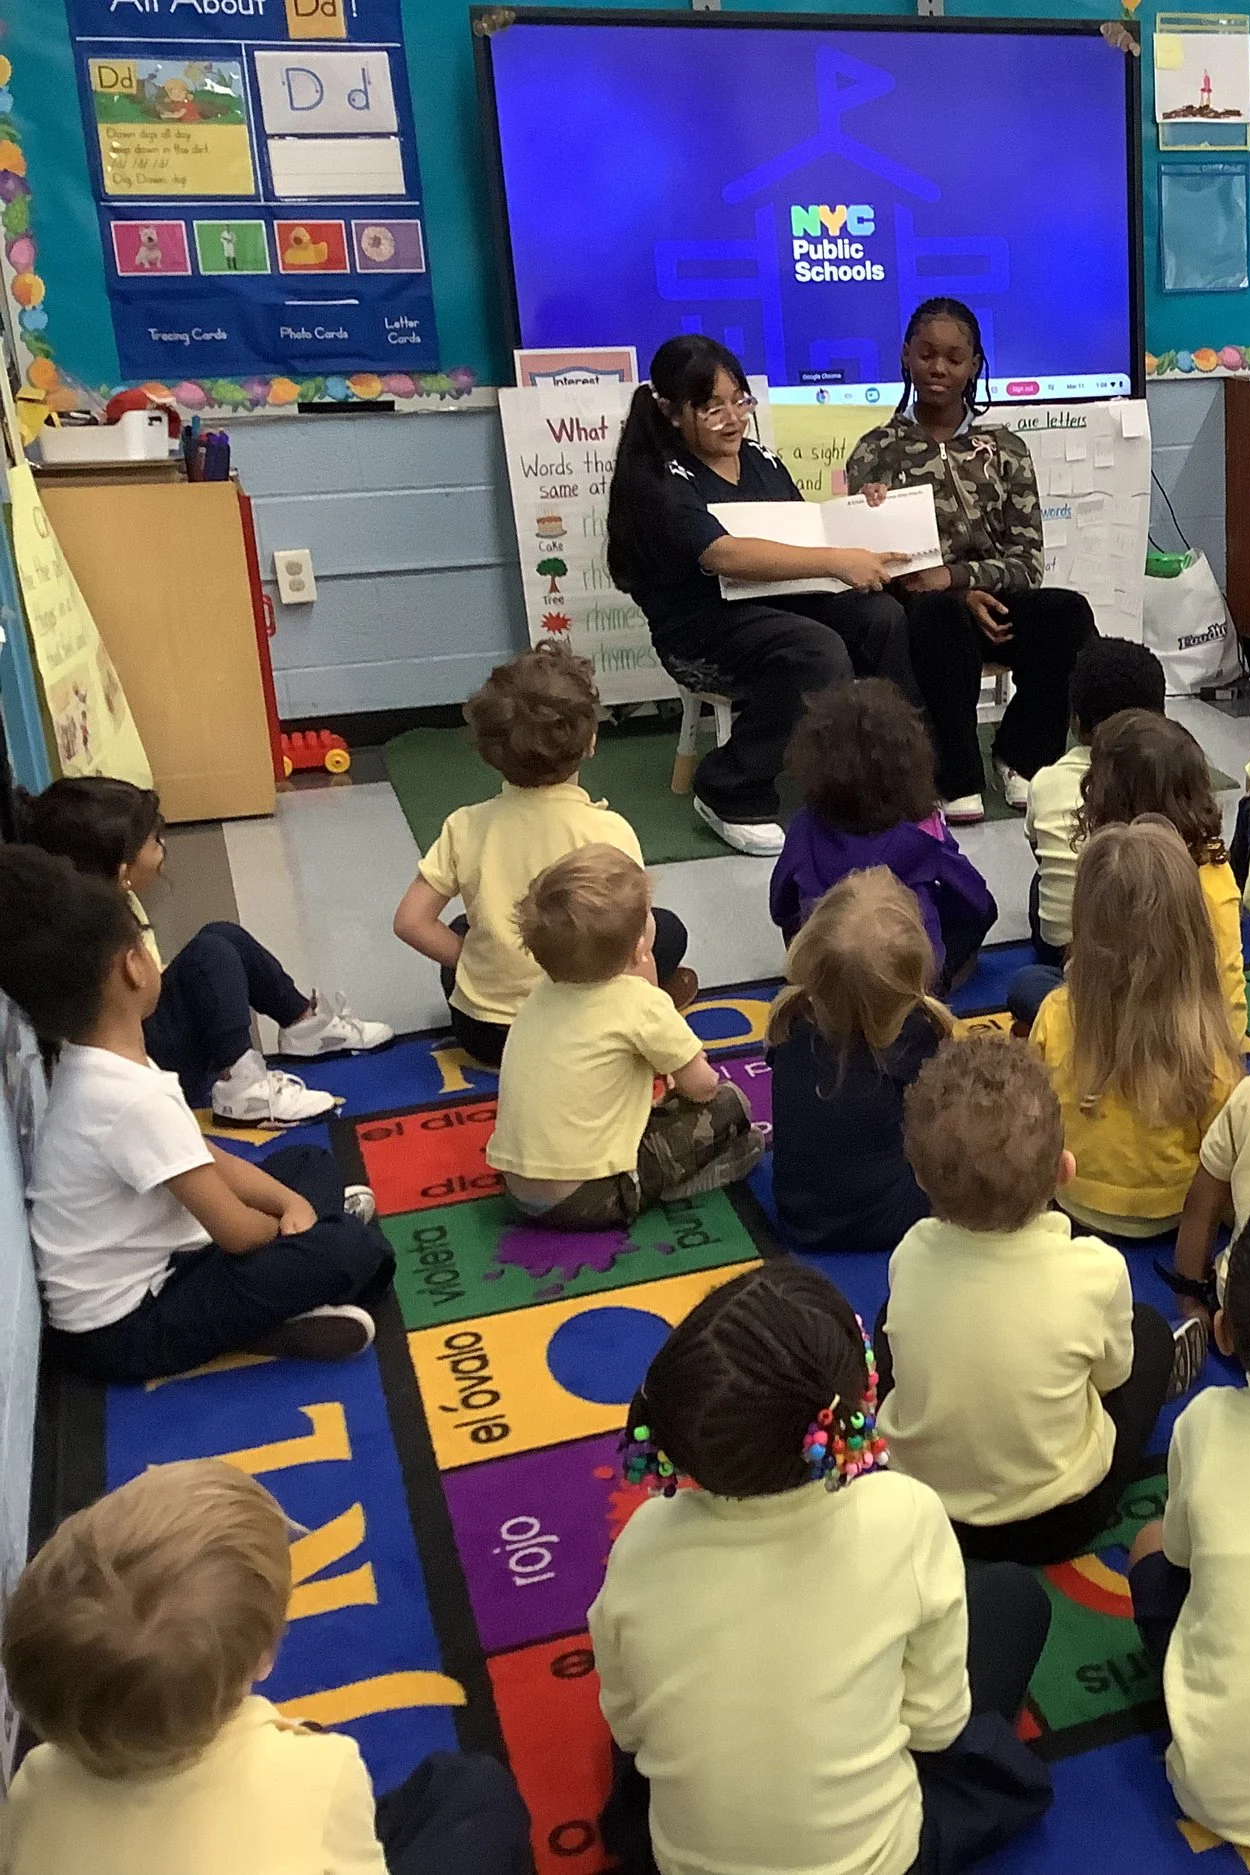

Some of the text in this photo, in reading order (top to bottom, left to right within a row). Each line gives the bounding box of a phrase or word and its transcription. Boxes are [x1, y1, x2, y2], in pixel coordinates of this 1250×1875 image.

[98, 65, 134, 89] Dd
[791, 204, 876, 237] NYC
[793, 238, 864, 260] Public
[795, 260, 885, 283] Schools
[279, 326, 349, 340] Photo Cards
[546, 414, 609, 444] What
[1046, 410, 1087, 429] letters
[520, 451, 574, 479] Words
[811, 437, 847, 467] sight
[539, 475, 607, 500] same at
[538, 540, 564, 552] Cake
[585, 601, 647, 633] rhymes
[411, 1225, 466, 1307] violeta
[436, 1330, 511, 1445] el óvalo
[492, 1514, 560, 1587] rojo
